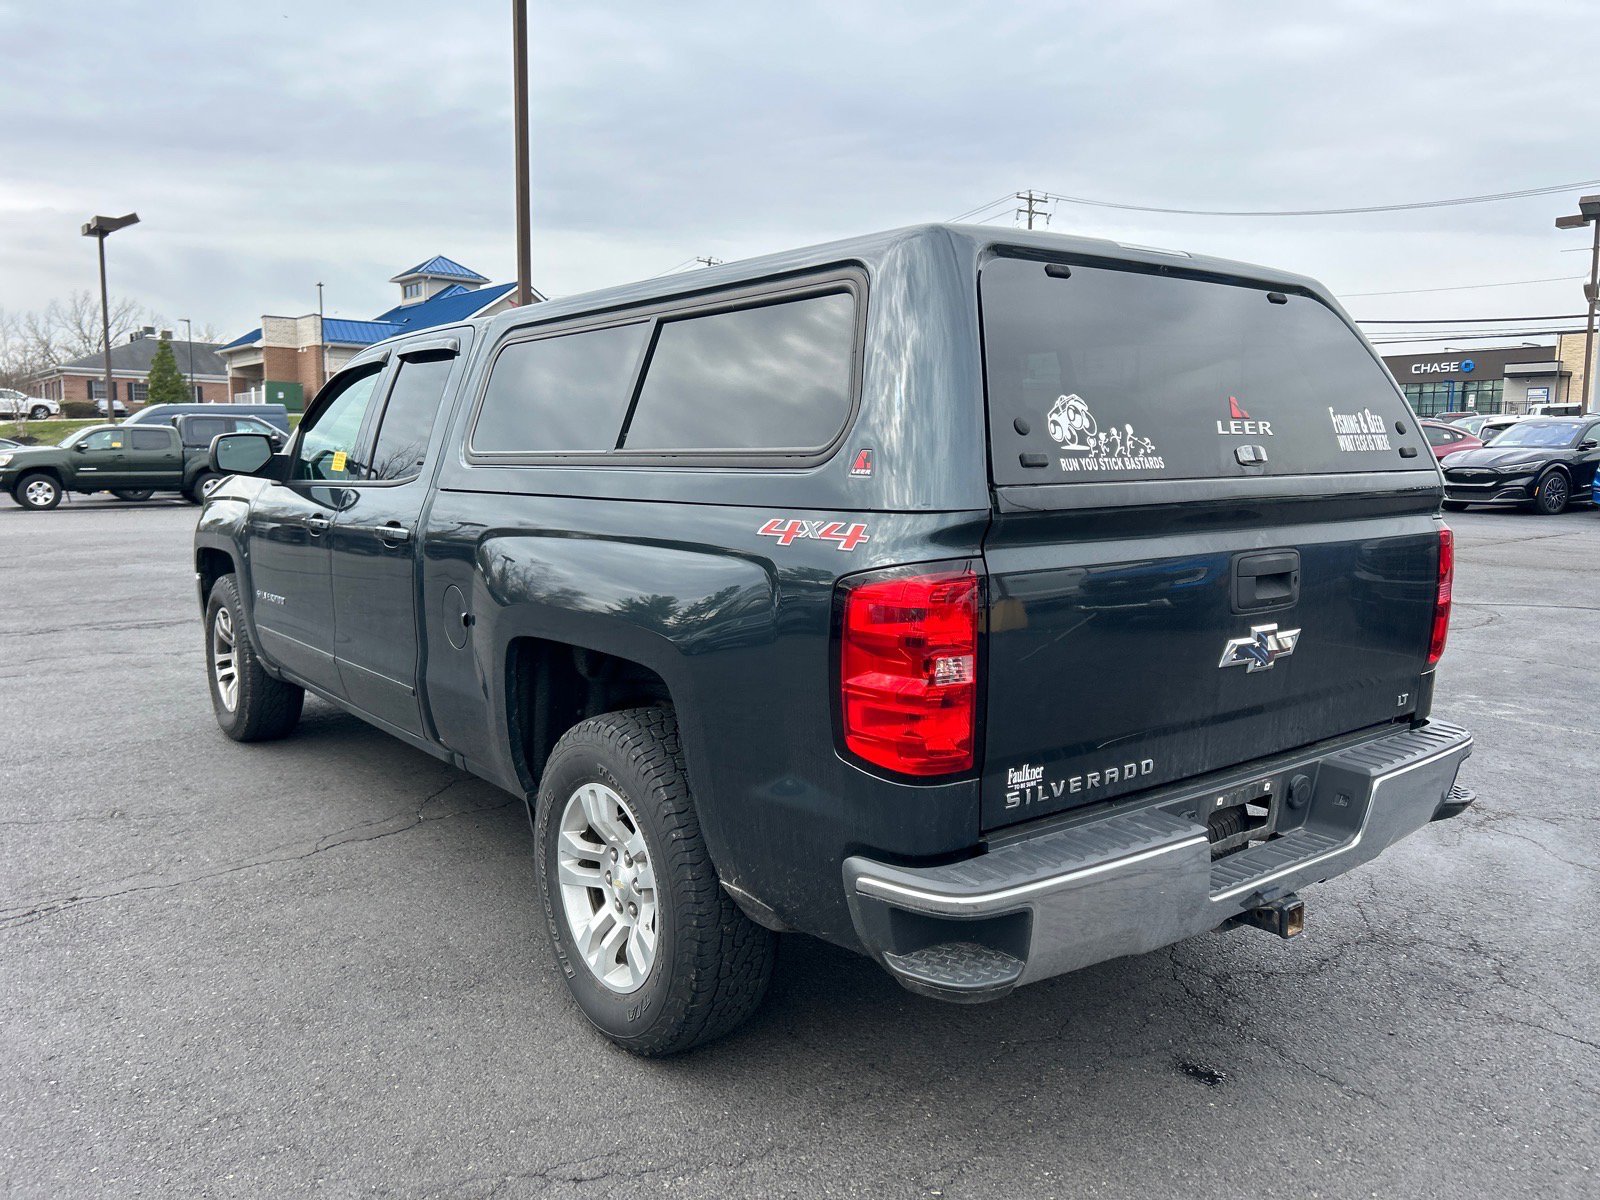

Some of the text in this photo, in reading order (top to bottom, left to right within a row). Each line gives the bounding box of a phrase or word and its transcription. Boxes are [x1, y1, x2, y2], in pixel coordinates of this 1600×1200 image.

[1411, 361, 1459, 374] CHASE
[1216, 420, 1274, 436] LEER
[1357, 411, 1369, 434] &
[1364, 407, 1387, 434] BEER
[1336, 434, 1357, 452] WHAT
[1352, 434, 1370, 451] ELSE
[1364, 434, 1376, 451] IS
[1060, 456, 1165, 471] RUN YOU STICK BASTARDS
[1396, 693, 1409, 707] LT
[1007, 763, 1044, 785] Faulkner
[1005, 758, 1155, 809] SILVERADO
